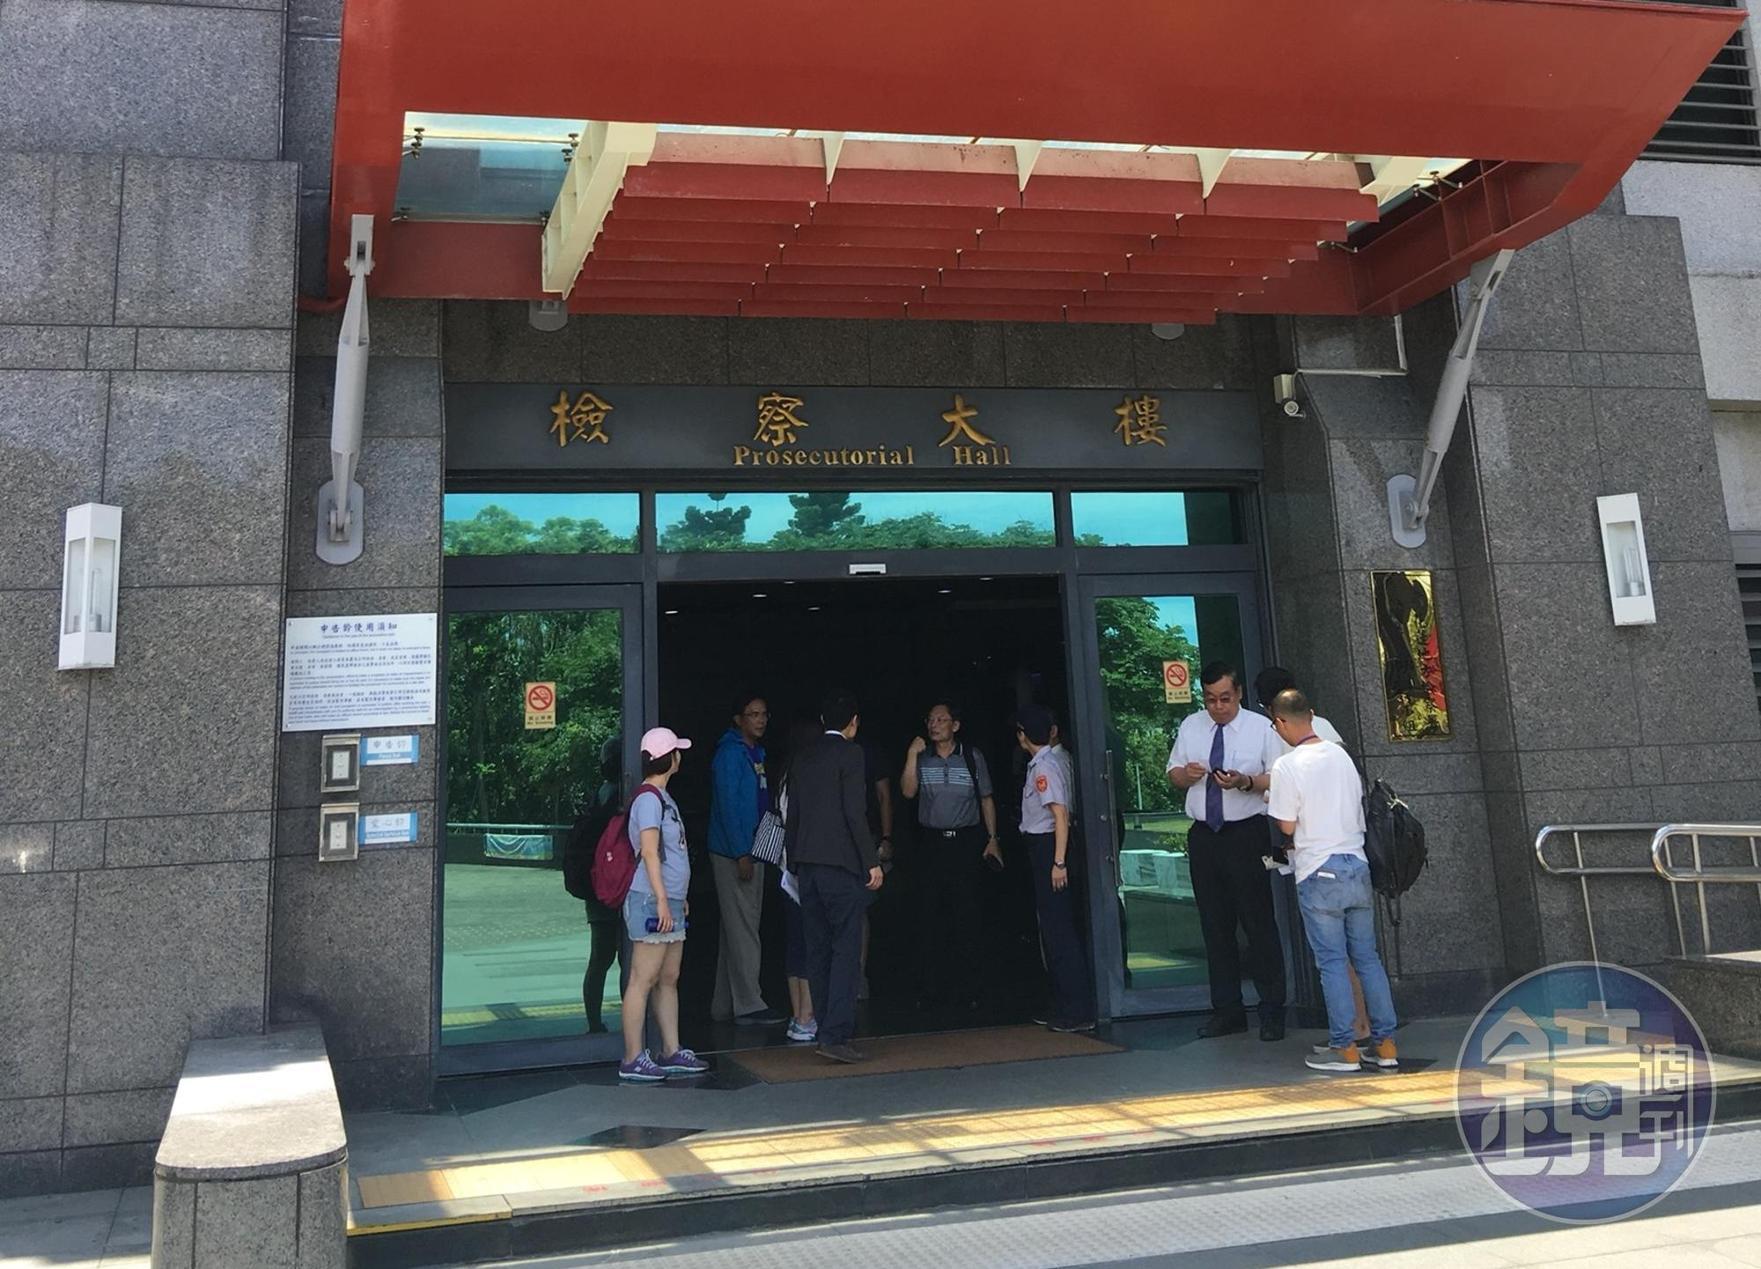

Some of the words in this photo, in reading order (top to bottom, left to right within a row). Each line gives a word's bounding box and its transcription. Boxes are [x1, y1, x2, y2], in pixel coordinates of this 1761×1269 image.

[551, 392, 1165, 448] 檢察大樓
[733, 443, 916, 467] Prosecutorial
[954, 444, 1012, 466] Hall
